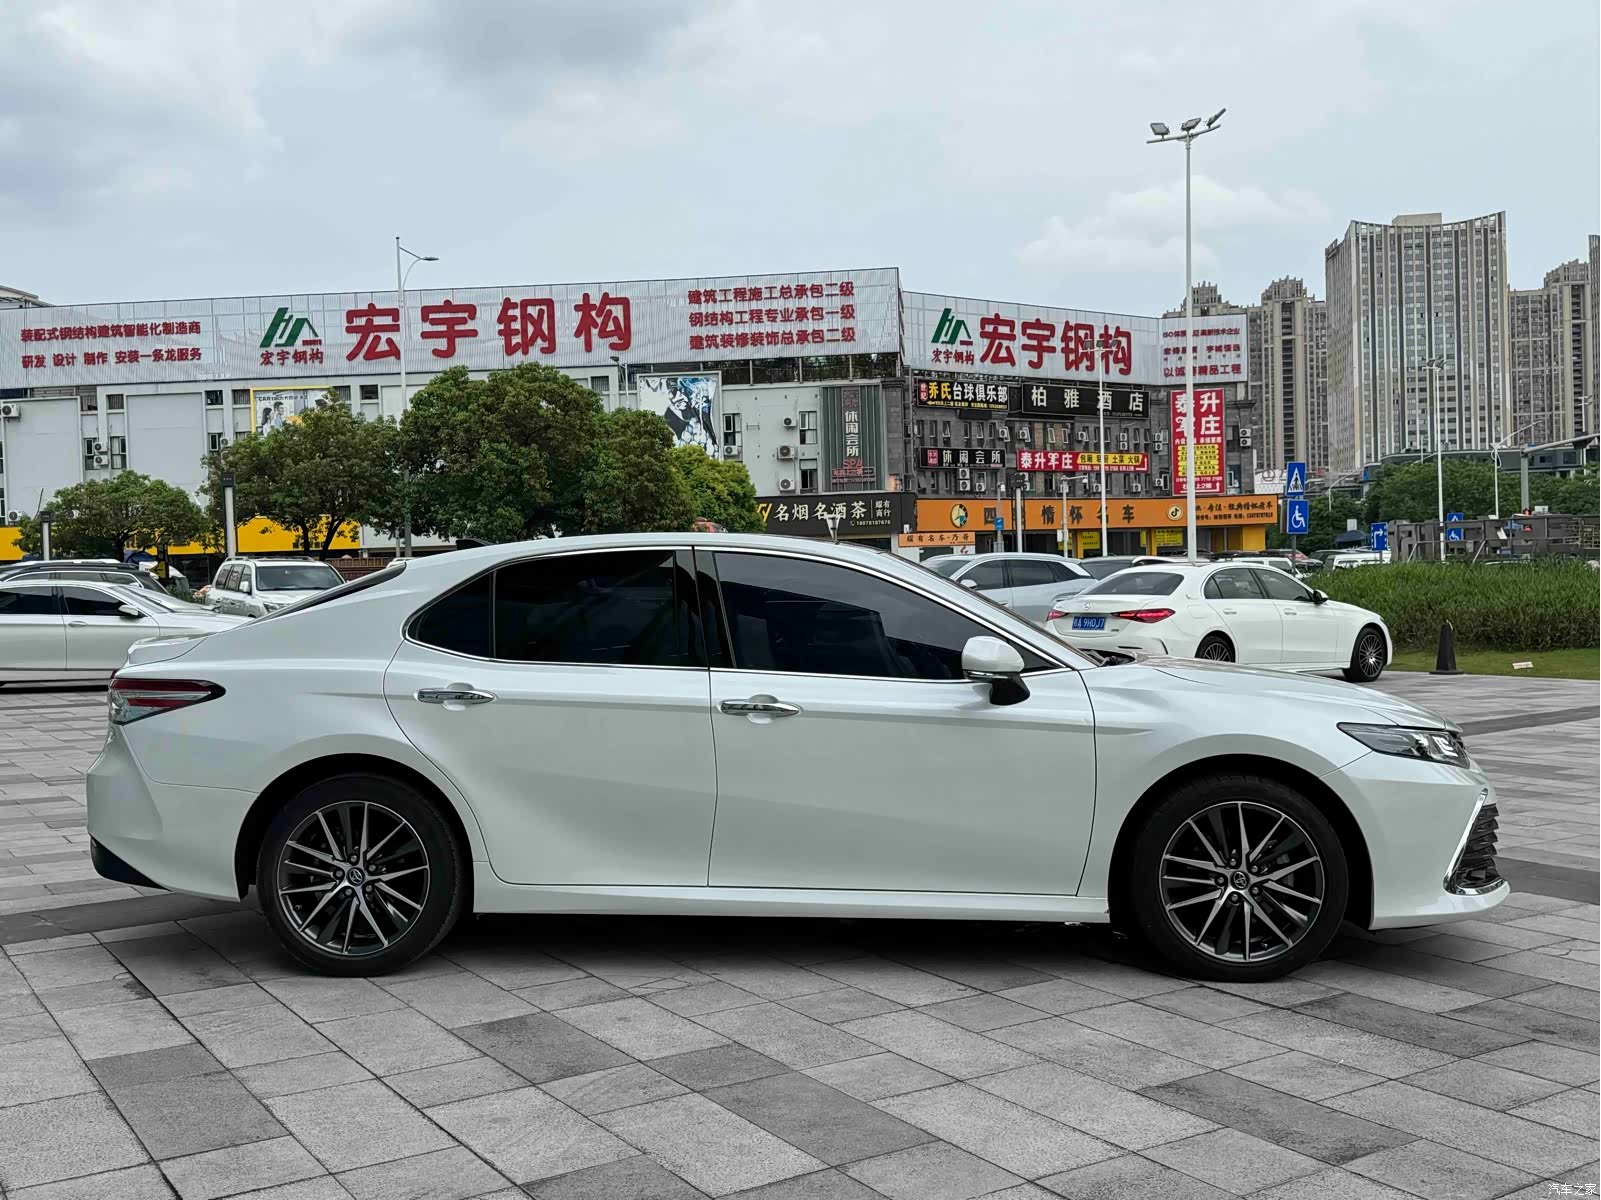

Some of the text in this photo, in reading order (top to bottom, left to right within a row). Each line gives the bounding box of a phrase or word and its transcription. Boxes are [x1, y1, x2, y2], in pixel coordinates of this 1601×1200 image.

[688, 281, 855, 305] 建筑工程施工总承包二级
[689, 304, 856, 327] 钢结构工程专业承包一级
[20, 321, 201, 342] 装配式钢结构建筑智能化制造商
[345, 292, 632, 362] 宏宇钢构
[689, 327, 856, 350] 建筑装修装饰总承包二级
[979, 312, 1132, 376] 宏宇钢构
[21, 347, 202, 369] 研发 设计 制作 安装一条龙服务
[260, 347, 324, 366] 宏宇钢构
[931, 348, 975, 366] 宏宇钢构
[928, 381, 1008, 403] 乔氏台球俱乐部
[1031, 386, 1144, 412] 柏雅酒店
[845, 410, 859, 457] 休闲会所
[842, 459, 863, 469] SPA
[942, 449, 1001, 464] 休闲会所
[774, 500, 867, 521] 名烟名酒茶
